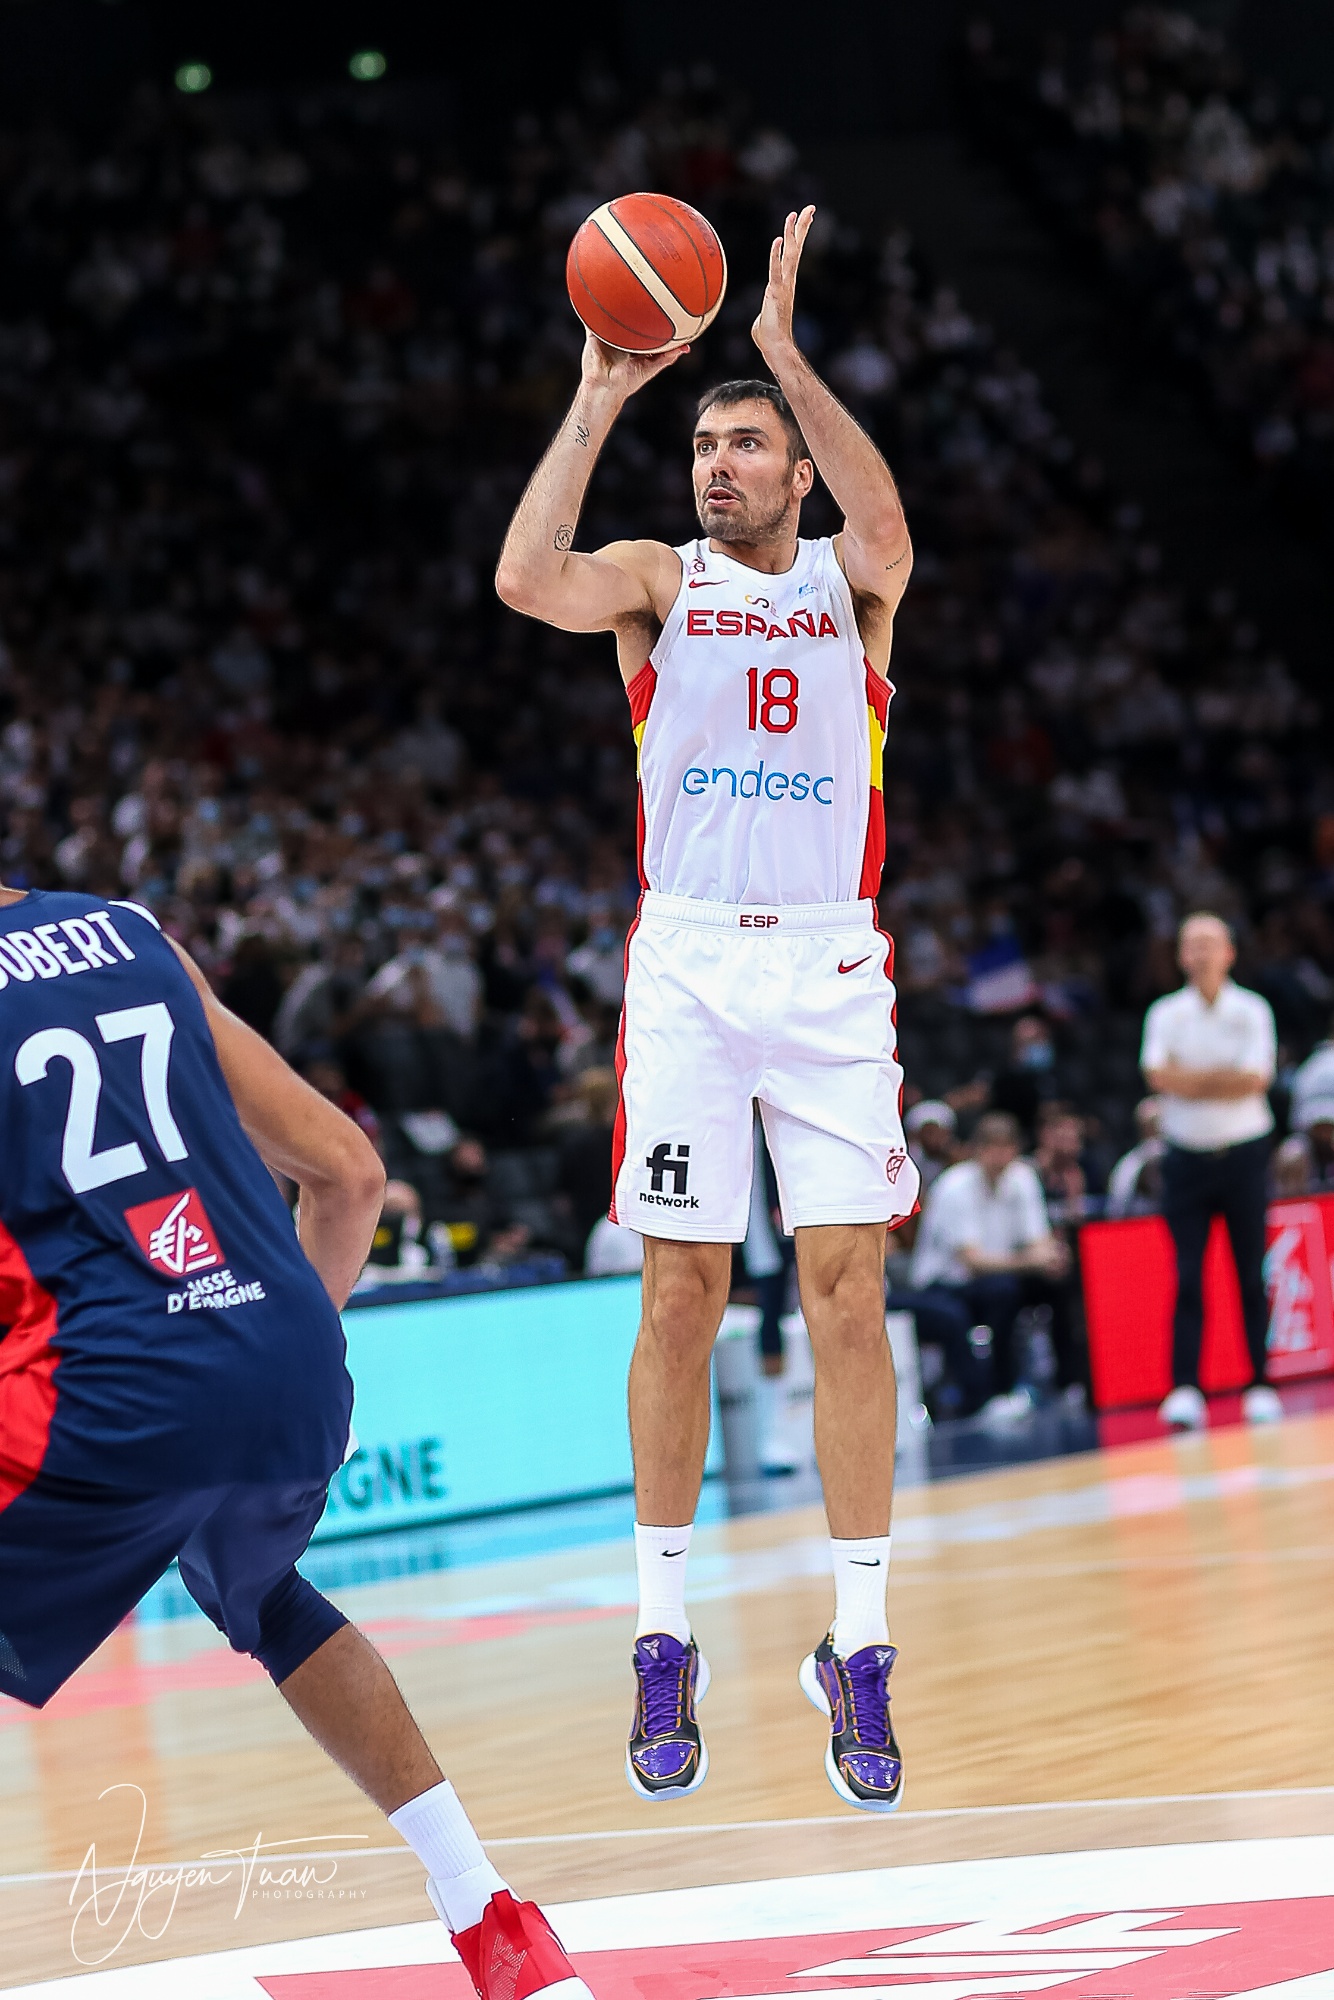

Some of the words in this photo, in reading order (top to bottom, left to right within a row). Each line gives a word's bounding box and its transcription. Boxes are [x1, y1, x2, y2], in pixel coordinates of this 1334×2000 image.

[686, 608, 839, 642] ESPAÑA
[745, 667, 799, 734] 18
[0, 910, 136, 991] OBERT
[739, 914, 779, 929] ESP
[14, 1001, 189, 1195] 27
[646, 1143, 690, 1195] fi
[639, 1192, 700, 1209] network
[325, 1436, 447, 1516] GNE
